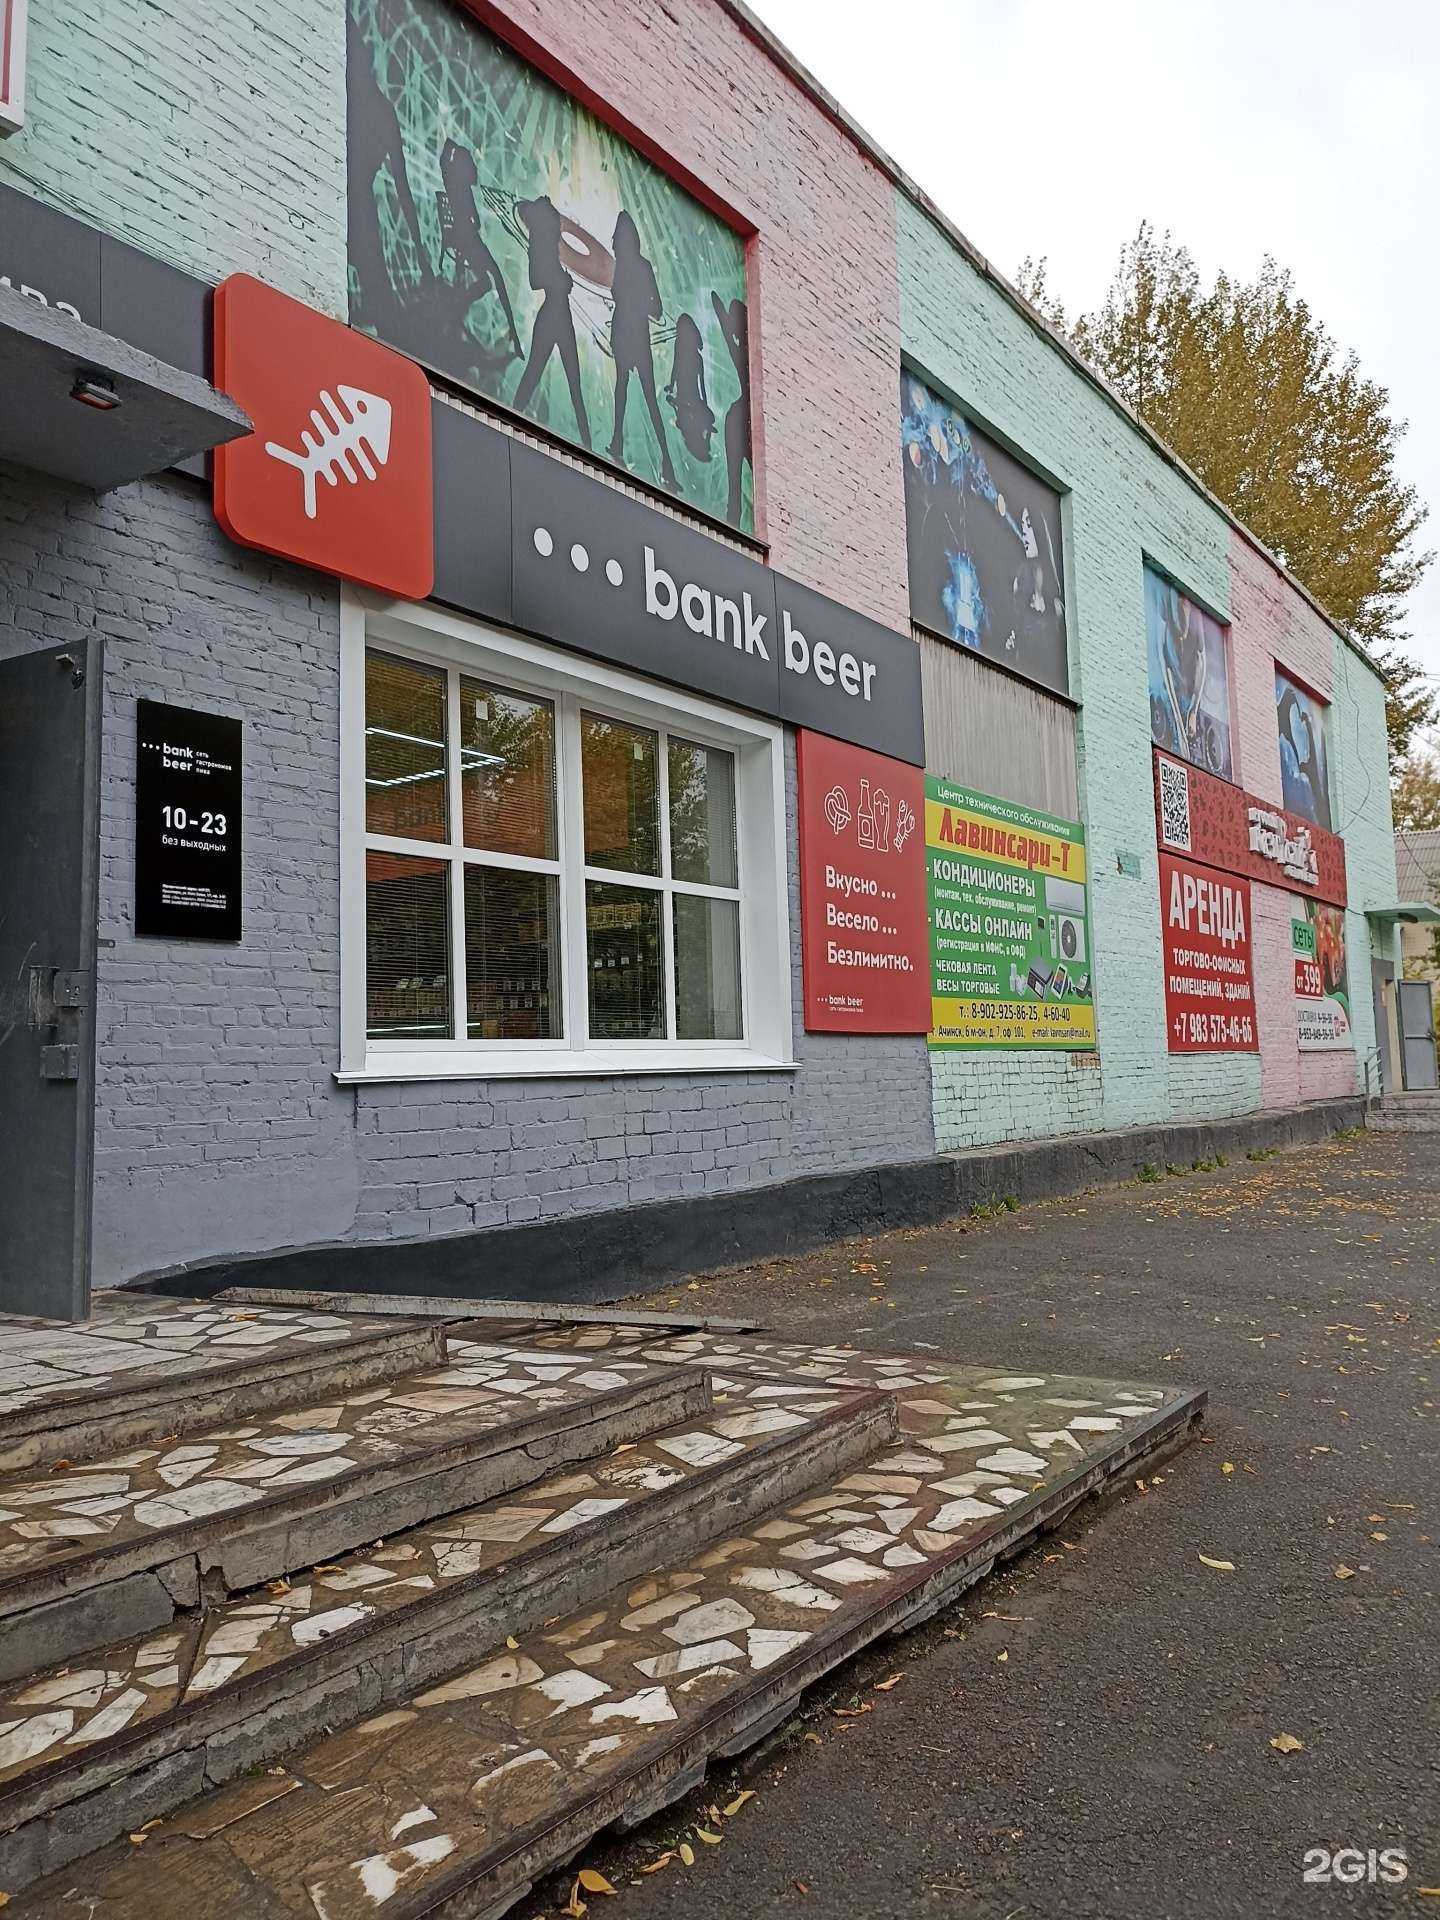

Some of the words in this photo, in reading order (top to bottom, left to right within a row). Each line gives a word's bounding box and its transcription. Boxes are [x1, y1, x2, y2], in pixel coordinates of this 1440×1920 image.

[643, 545, 770, 661] bank
[782, 609, 877, 701] beer
[163, 742, 193, 759] bank
[163, 755, 193, 771] beer
[937, 785, 964, 805] Центр
[965, 795, 1019, 821] технического
[1019, 813, 1070, 836] обслуживания
[162, 834, 178, 846] без
[180, 839, 226, 852] выходных
[939, 807, 1071, 872] Лавинсари-Т
[933, 858, 1036, 898] КОНДИЦИОНЕРЫ
[1169, 870, 1246, 950] АРЕНДА
[935, 908, 982, 934] КАССЫ
[984, 916, 1033, 941] ОНЛАЙН
[827, 941, 914, 972] Безлимитно.
[936, 960, 971, 972] ЧЕКОВАЯ
[973, 963, 997, 976] ЛЕНТА
[1173, 948, 1246, 975] ТОРГОВО-ОФИСНЫХ
[937, 979, 959, 992] ВЕСЫ
[961, 980, 1000, 995] ТОРГОВЫЕ
[1169, 975, 1224, 1000] ПОМЕЩЕНИЙ,
[1224, 982, 1250, 1001] ЗДАНИЙ
[1303, 964, 1321, 994] 399
[829, 994, 846, 1005] bank
[847, 996, 864, 1006] beer
[1043, 1007, 1070, 1021] 4-60-40
[1174, 1012, 1187, 1043] +7
[1190, 1013, 1208, 1043] 983
[1210, 1014, 1252, 1044] 575-46-66
